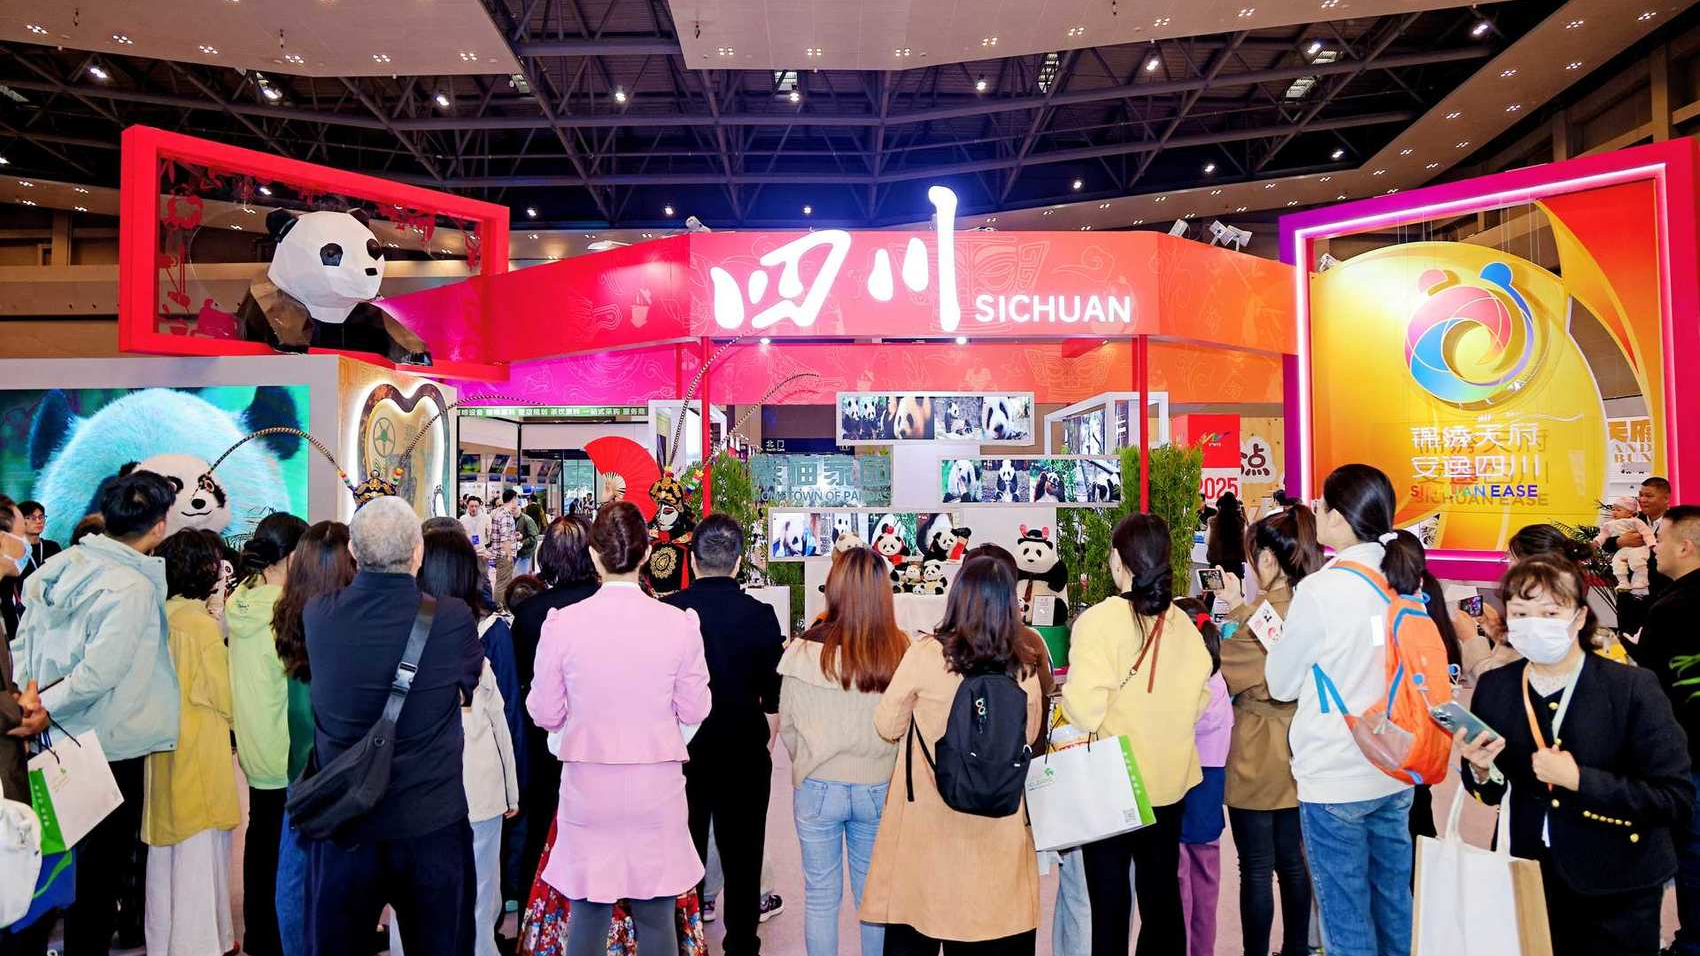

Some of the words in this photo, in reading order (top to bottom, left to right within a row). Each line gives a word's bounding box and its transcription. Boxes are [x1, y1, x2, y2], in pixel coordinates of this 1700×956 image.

[710, 186, 961, 333] 四川
[975, 294, 1131, 323] SICHUAN
[766, 440, 785, 448] 北门
[1411, 454, 1540, 479] 安逸四川
[825, 491, 841, 500] OF
[1411, 485, 1486, 498] SICHUAN
[1491, 485, 1538, 497] EASE
